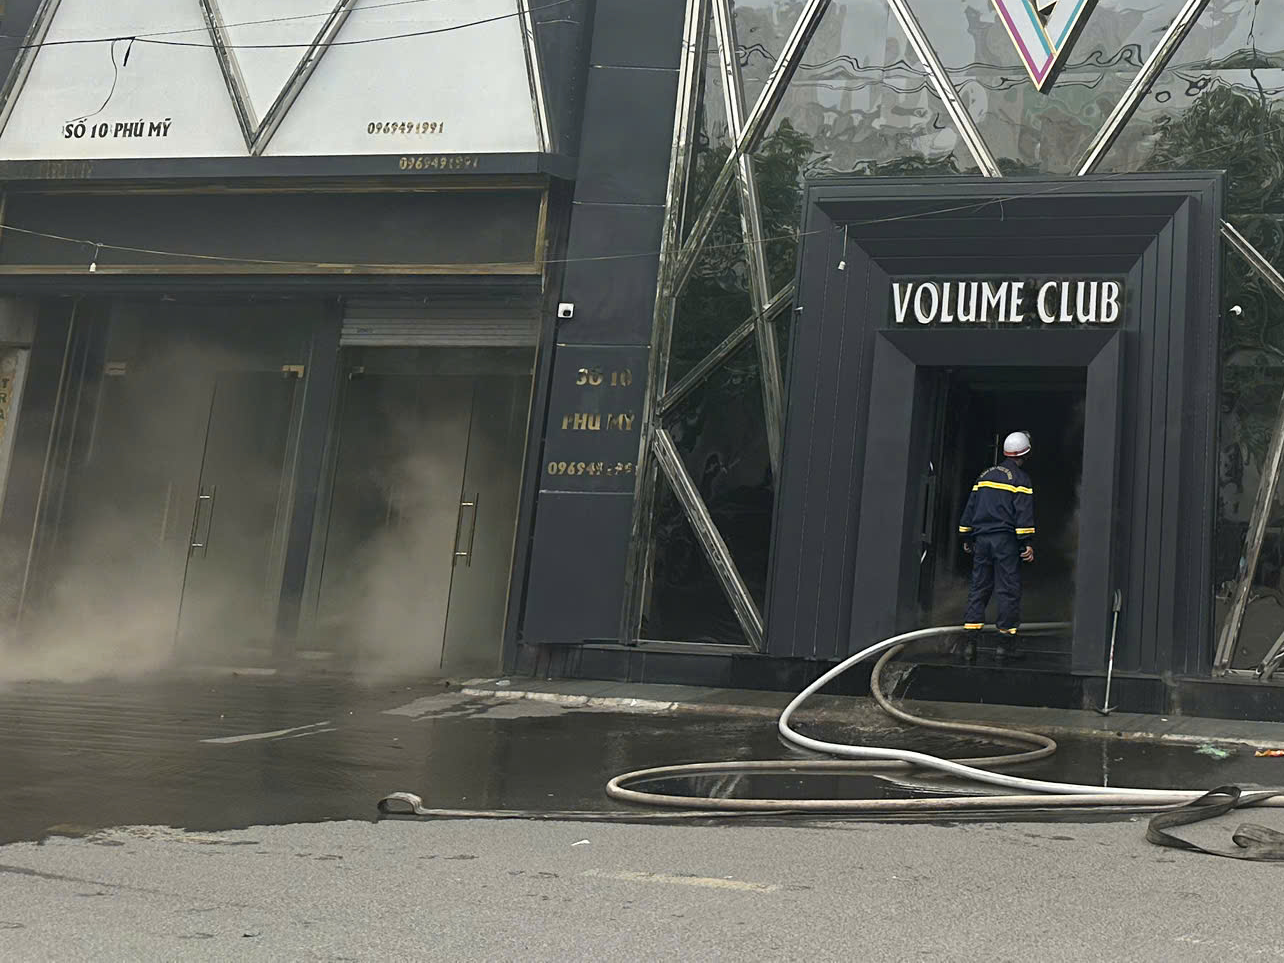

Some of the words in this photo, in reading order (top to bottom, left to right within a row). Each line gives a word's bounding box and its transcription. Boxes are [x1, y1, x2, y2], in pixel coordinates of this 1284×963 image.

[65, 118, 87, 138] SỐ
[91, 123, 108, 138] 10
[114, 119, 144, 138] PHÚ
[148, 118, 172, 137] MỸ
[892, 281, 1024, 324] VOLUME
[1036, 280, 1120, 324] CLUB
